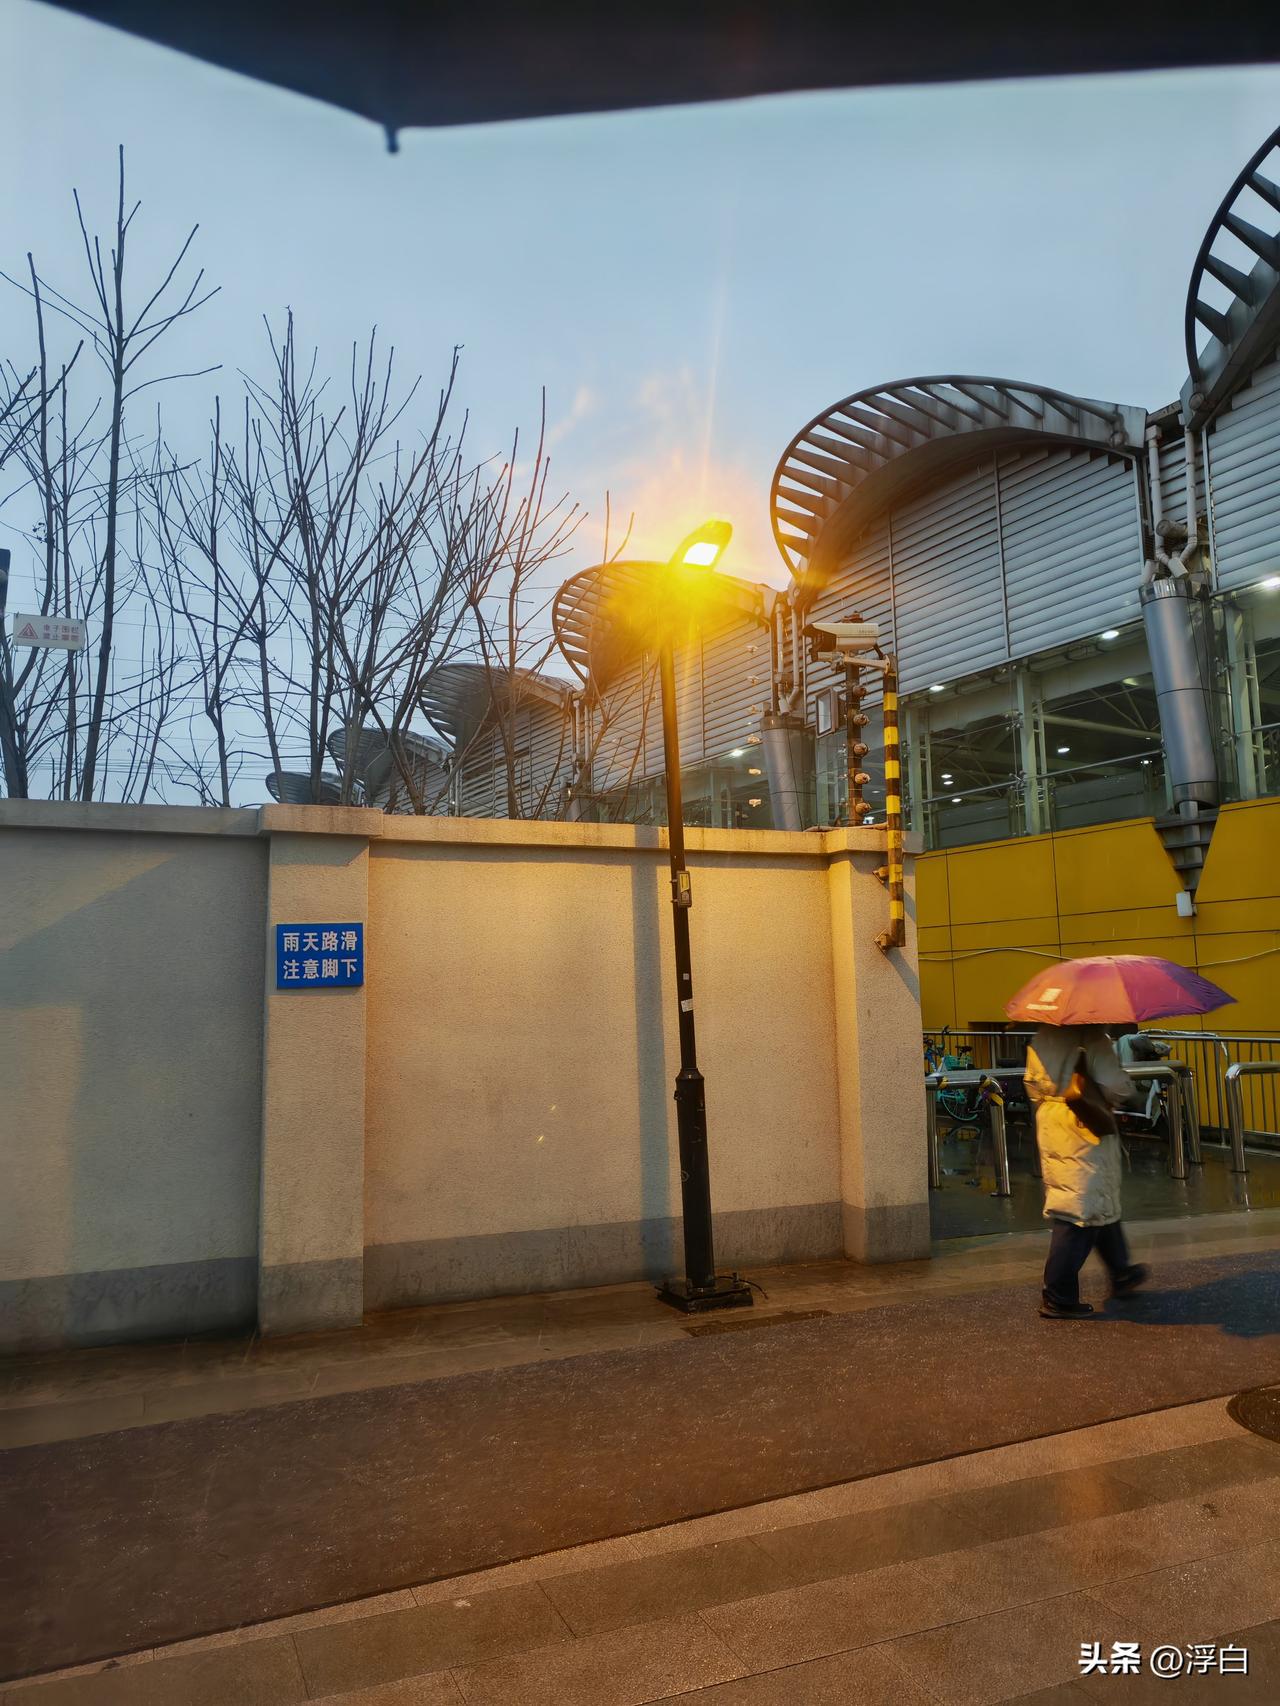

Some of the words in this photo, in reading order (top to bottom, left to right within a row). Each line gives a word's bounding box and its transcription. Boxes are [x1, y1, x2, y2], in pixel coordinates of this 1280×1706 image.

[283, 931, 358, 952] 雨天路滑
[283, 959, 358, 979] 注意脚下
